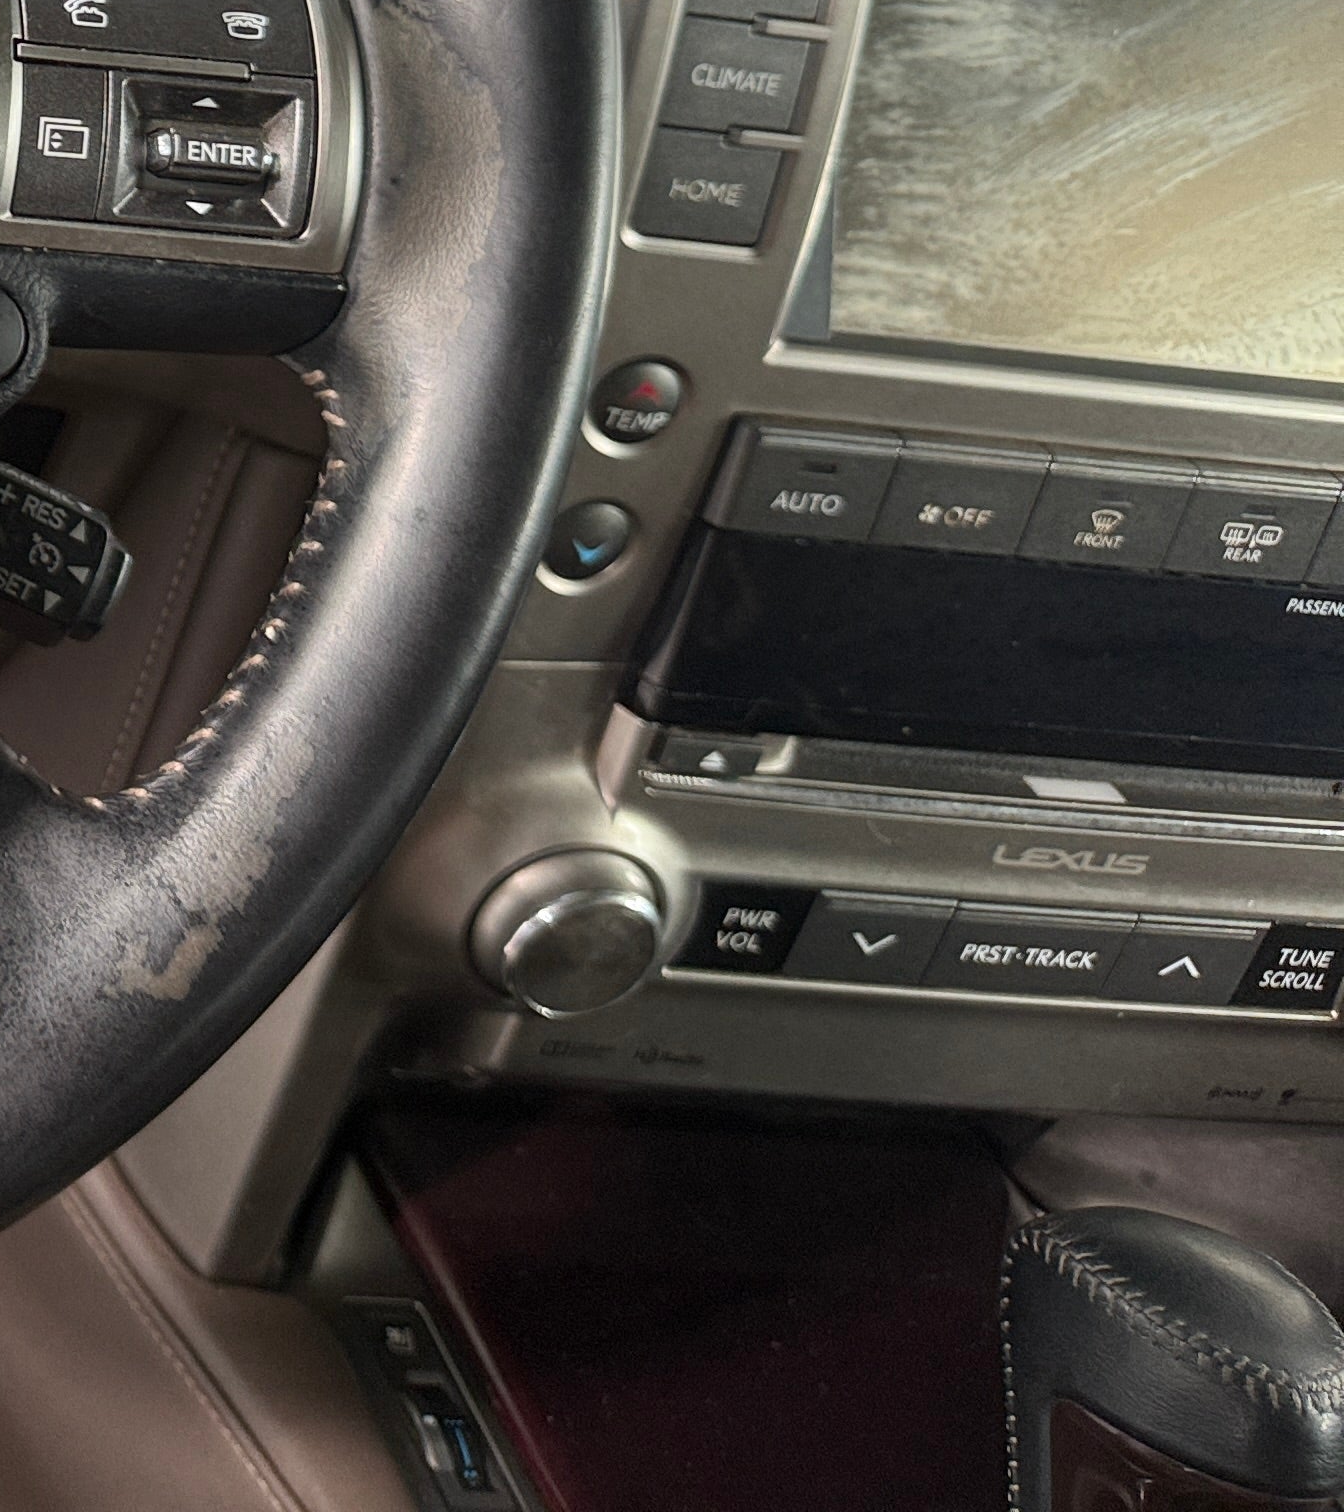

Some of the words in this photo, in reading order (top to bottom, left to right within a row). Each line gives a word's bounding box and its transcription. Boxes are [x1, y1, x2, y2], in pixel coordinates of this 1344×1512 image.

[691, 62, 785, 97] CLIMATE
[187, 140, 259, 167] ENTER
[668, 177, 747, 208] HOME
[605, 407, 669, 432] TEMP
[22, 494, 68, 530] RES
[771, 491, 846, 516] AUTO
[943, 505, 995, 529] OFF
[1073, 531, 1125, 550] FRONT
[1223, 546, 1263, 563] REAR
[992, 844, 1150, 875] LEXUS
[722, 907, 781, 932] PWR
[716, 930, 762, 954] VOL
[1278, 948, 1336, 969] TUNE
[1258, 969, 1326, 992] SCROLL
